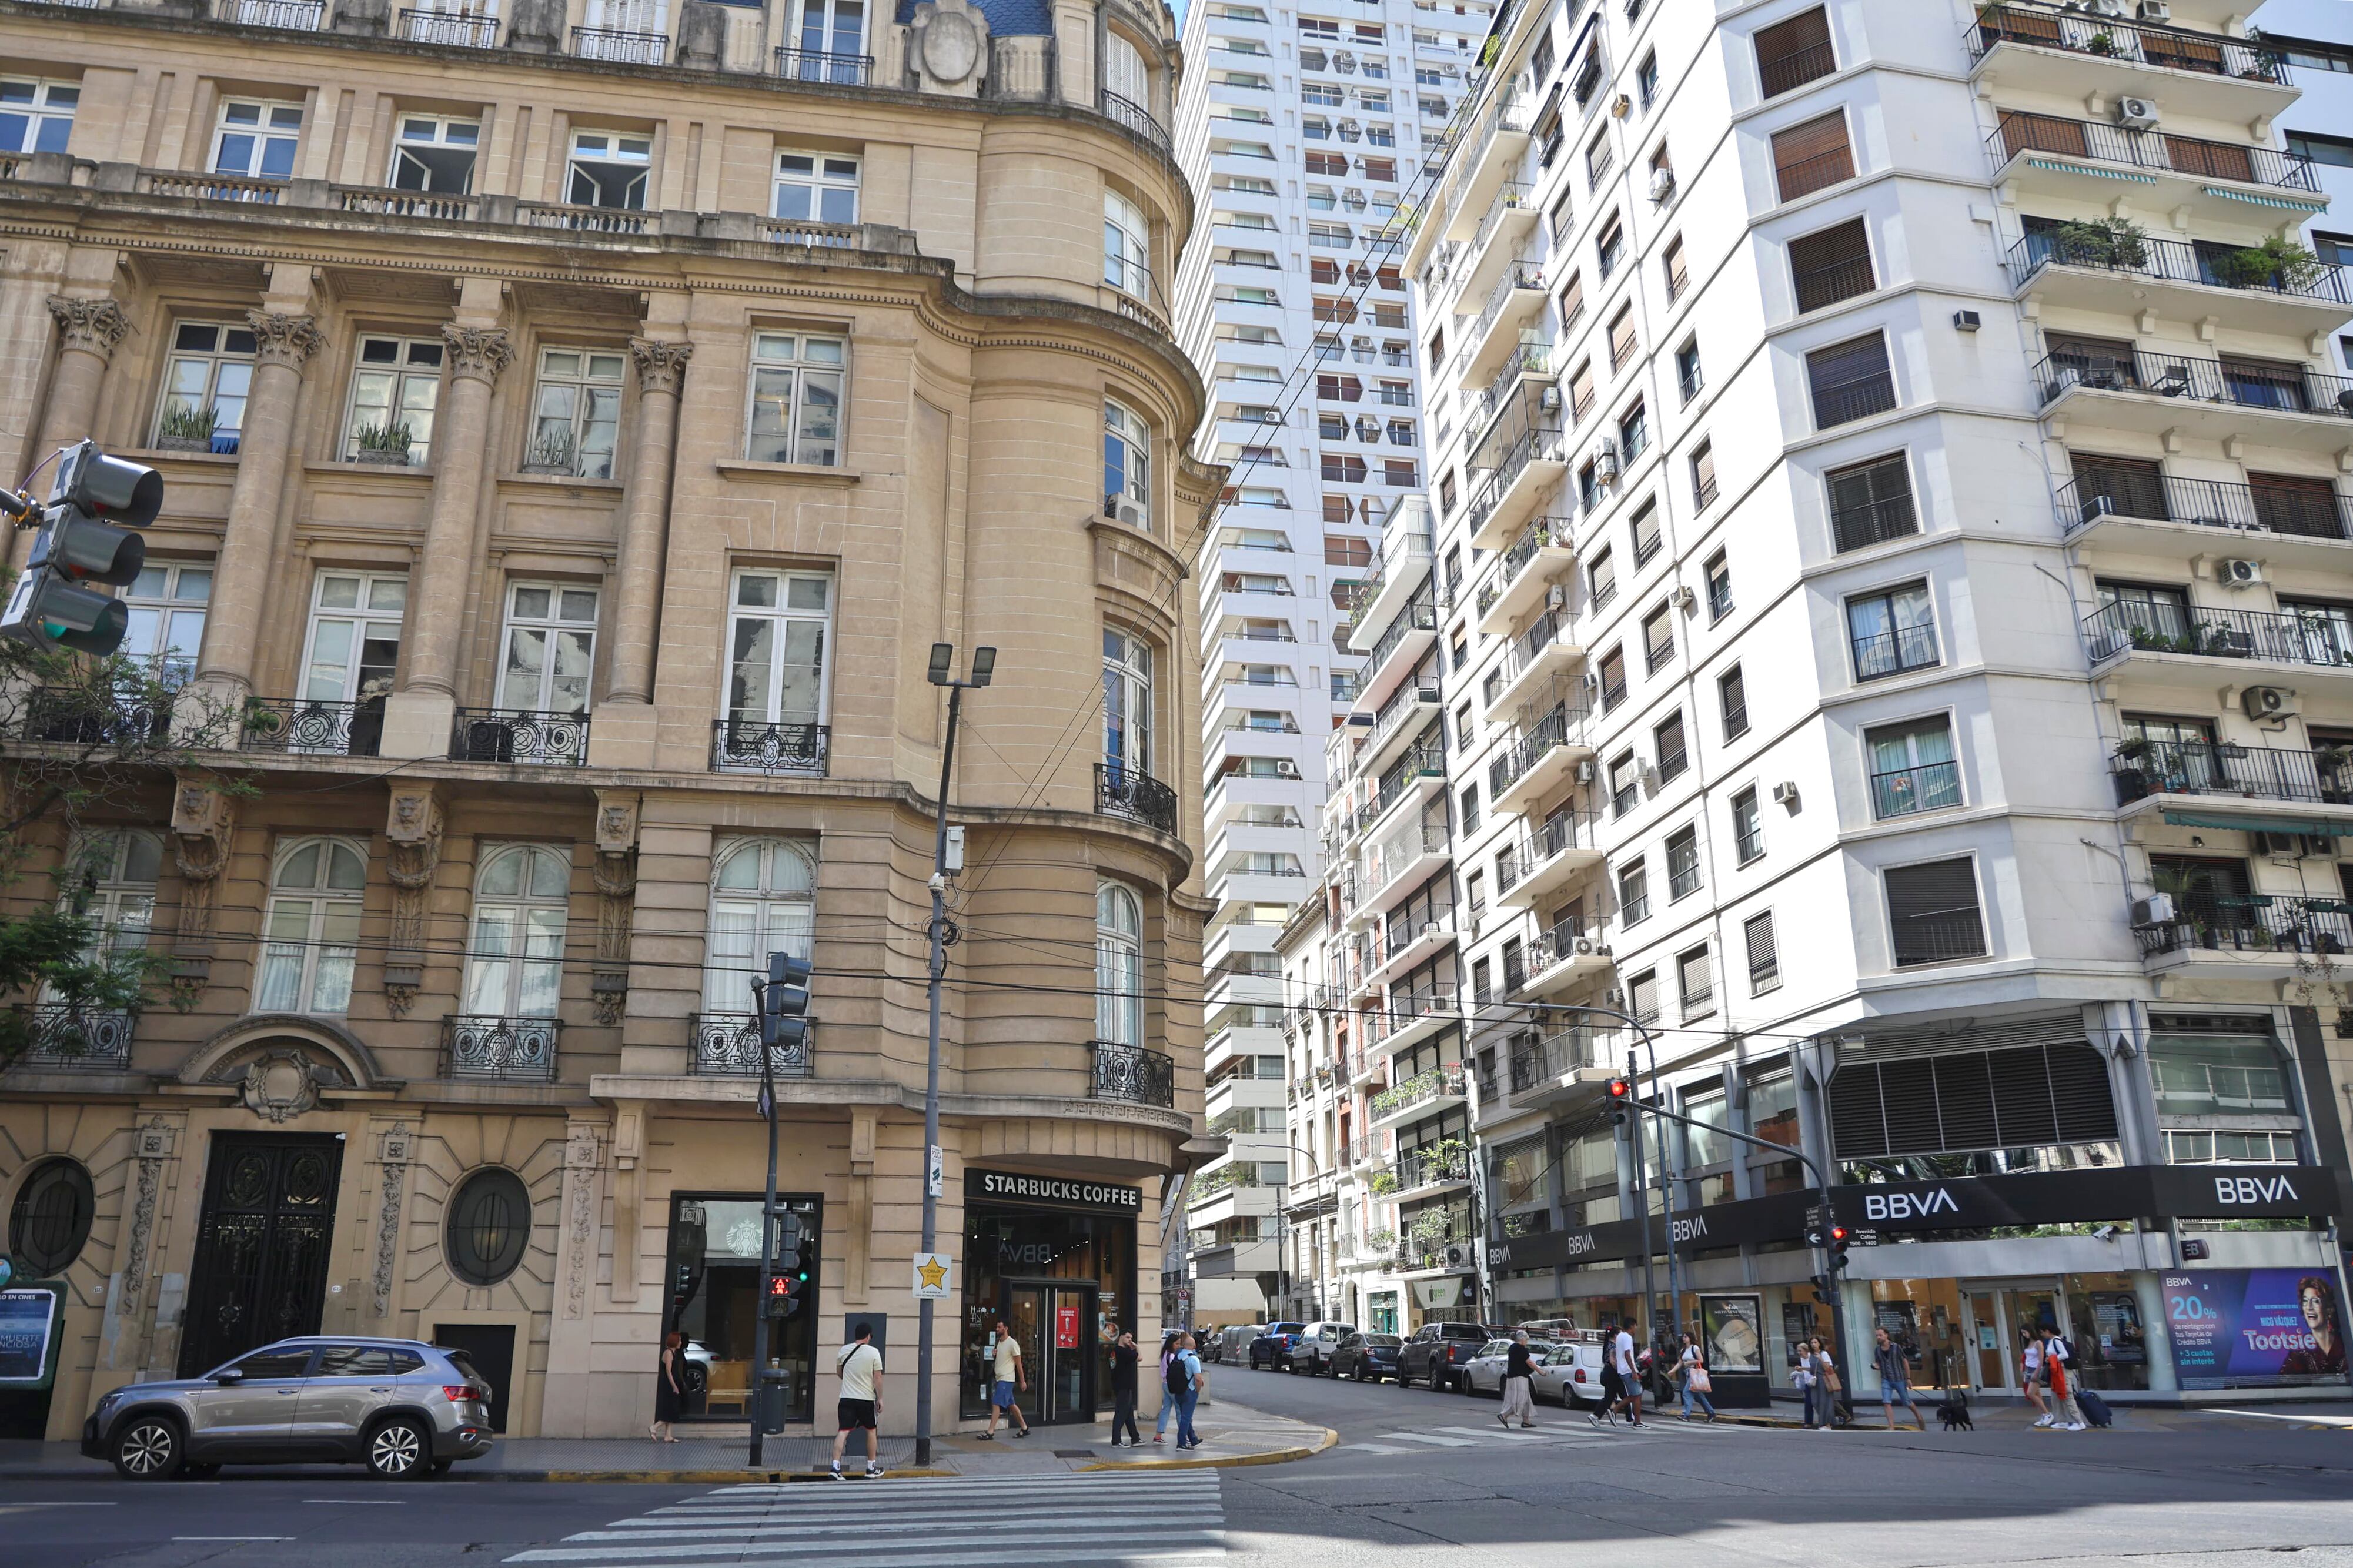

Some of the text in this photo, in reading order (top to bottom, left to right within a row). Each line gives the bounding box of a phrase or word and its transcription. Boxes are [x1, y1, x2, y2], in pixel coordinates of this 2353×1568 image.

[985, 1175, 1136, 1205] STARBUCKS COFFEE
[2215, 1175, 2298, 1203] BBVA
[1866, 1188, 1959, 1220] BBVA
[1673, 1215, 1708, 1242] BBVA
[1490, 1245, 1511, 1265] BBVA
[1569, 1232, 1595, 1255] BBVA
[2166, 1277, 2192, 1286] BBVA
[2171, 1296, 2217, 1320] 20%
[2260, 1317, 2274, 1326] NICO
[2242, 1328, 2317, 1350] Tootsie
